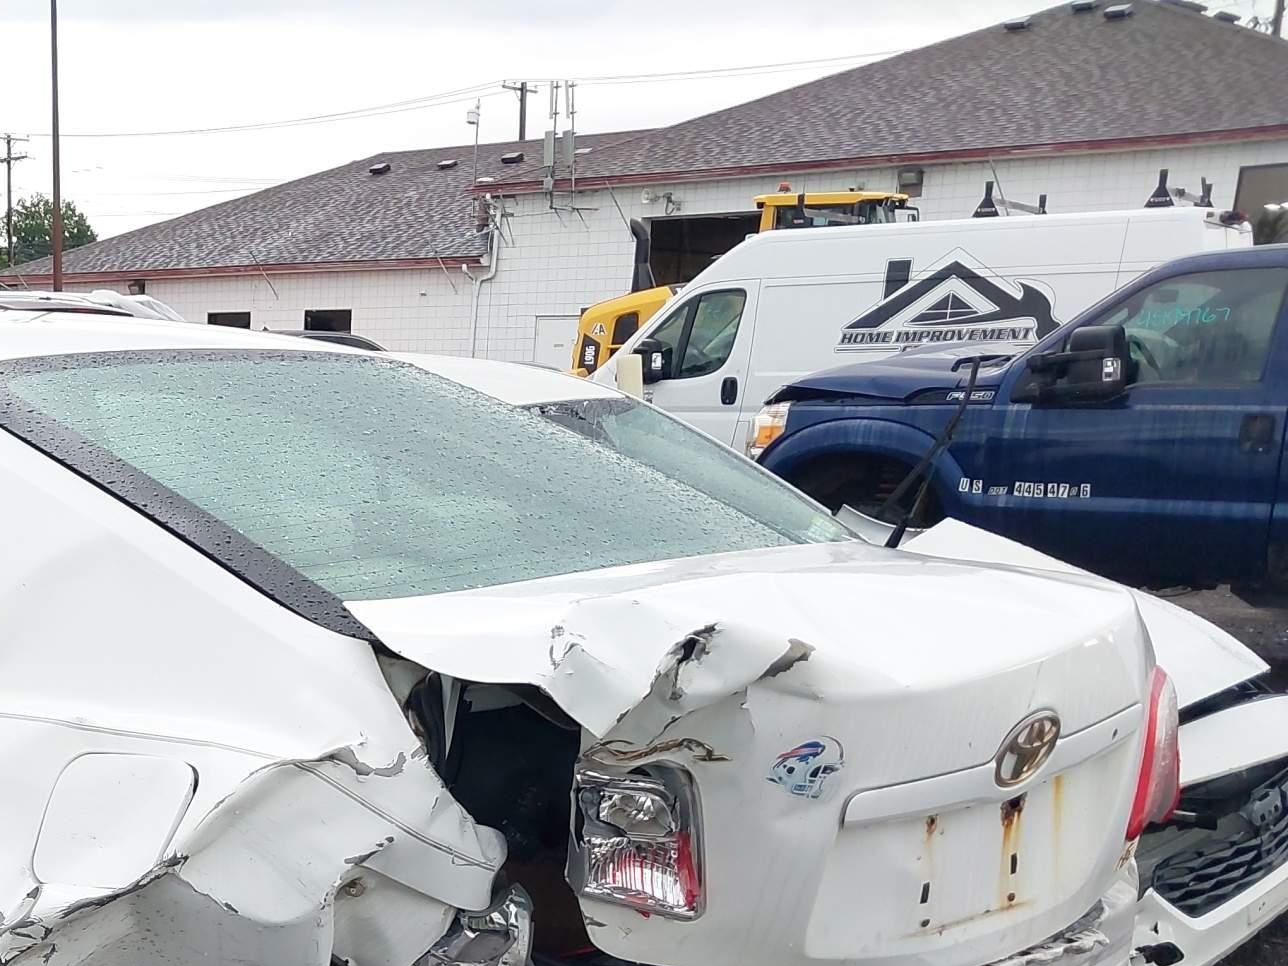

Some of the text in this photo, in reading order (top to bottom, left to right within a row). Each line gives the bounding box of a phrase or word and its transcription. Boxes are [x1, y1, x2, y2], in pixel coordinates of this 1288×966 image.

[841, 327, 1031, 344] HOME IMPROVEMENT
[584, 345, 596, 365] L90G
